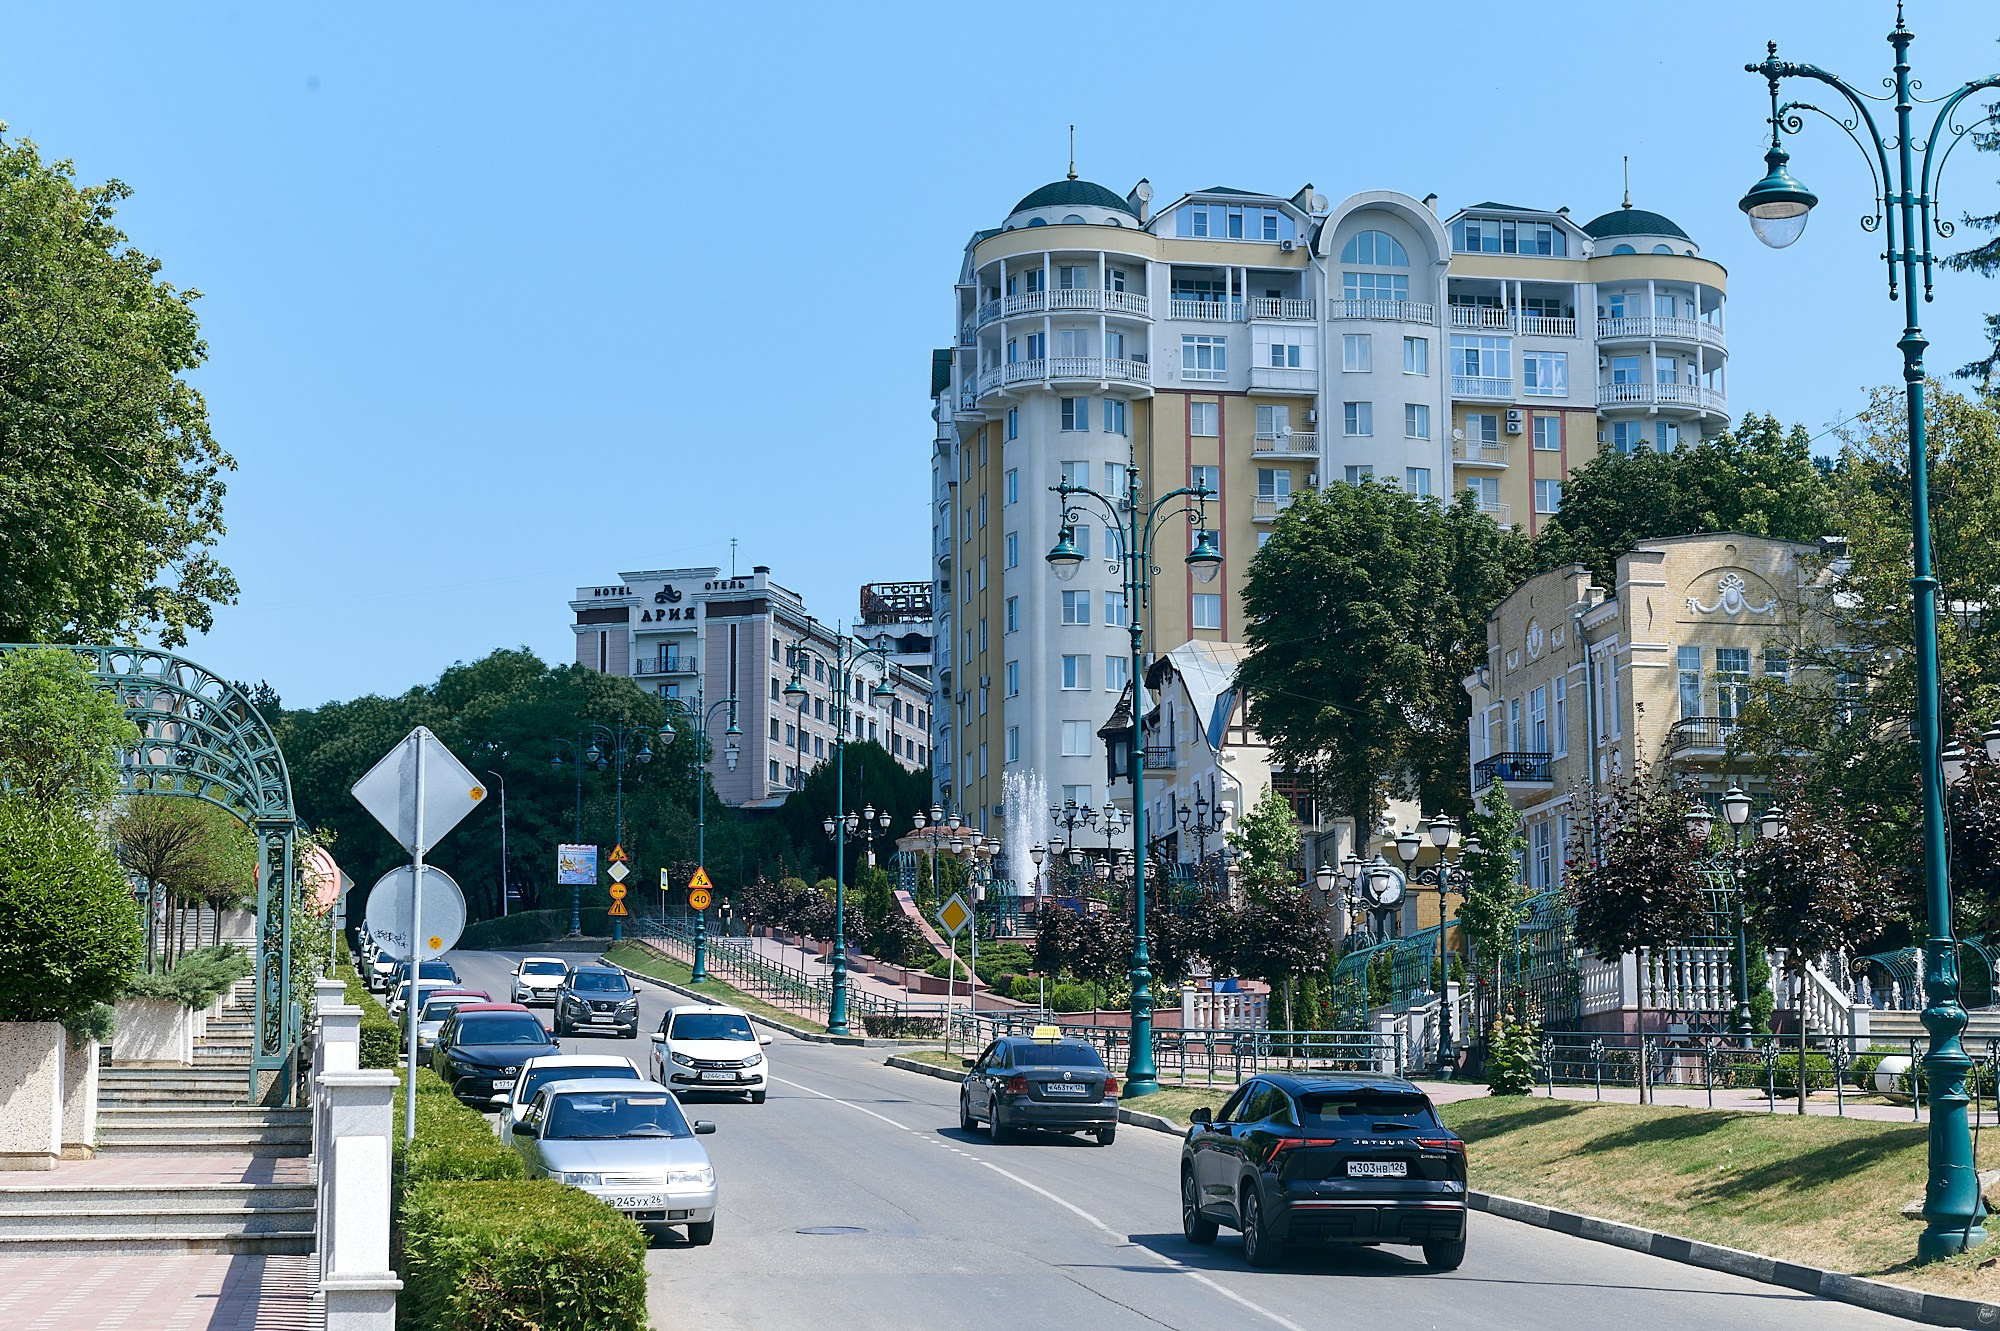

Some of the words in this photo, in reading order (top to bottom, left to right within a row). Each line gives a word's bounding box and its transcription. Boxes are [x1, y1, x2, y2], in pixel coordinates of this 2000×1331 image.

[705, 580, 745, 591] ОТЕЛЬ
[594, 586, 633, 597] HOTEL
[640, 607, 696, 623] АРИЯ
[694, 895, 707, 904] 40
[1350, 1162, 1388, 1173] М303НВ
[1390, 1162, 1405, 1171] 126
[651, 1195, 661, 1204] 26
